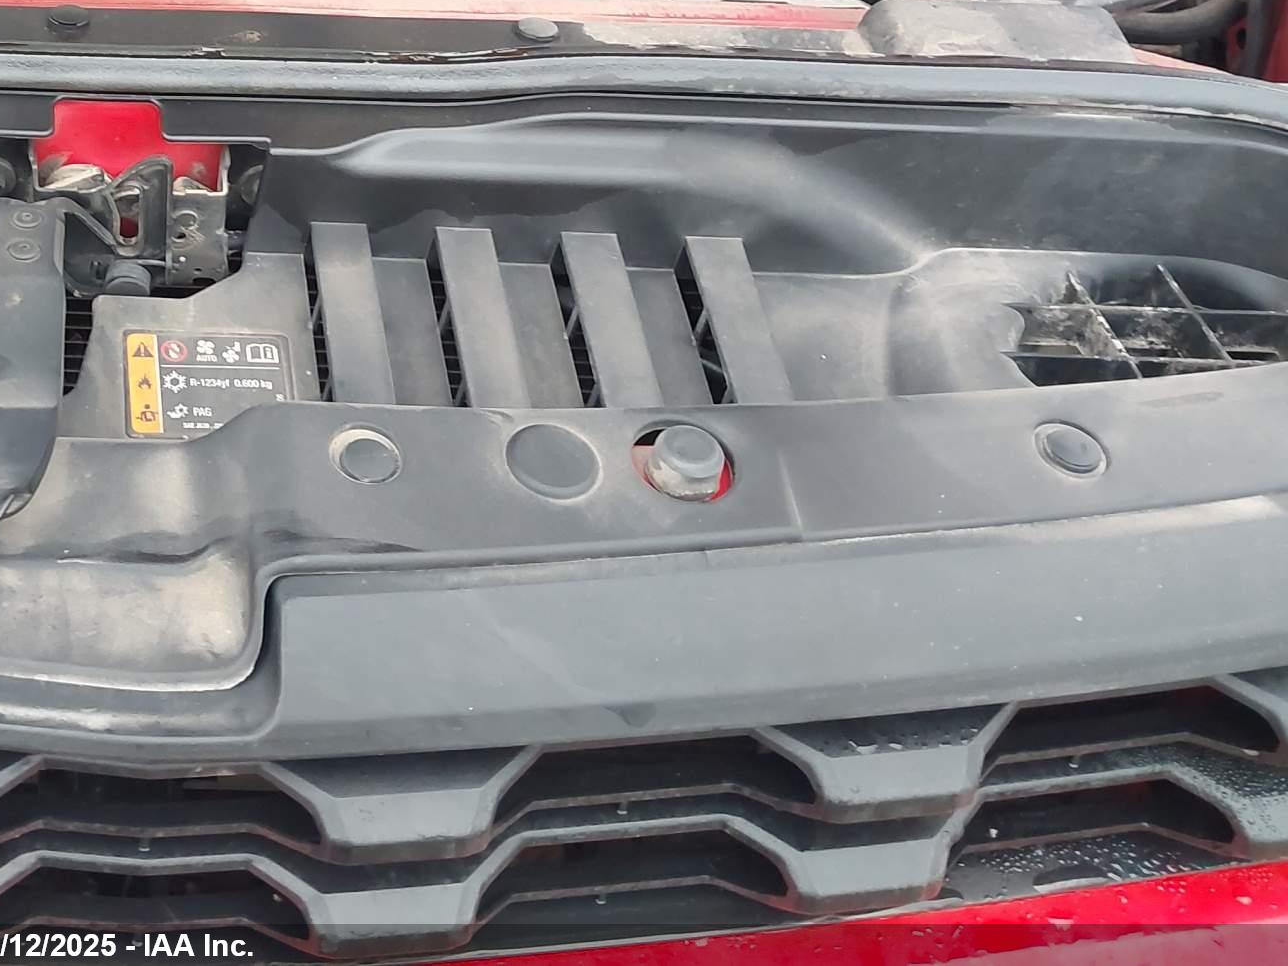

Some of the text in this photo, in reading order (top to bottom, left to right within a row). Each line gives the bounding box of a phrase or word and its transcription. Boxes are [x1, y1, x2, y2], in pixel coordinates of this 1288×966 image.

[196, 354, 218, 362] AUTO
[189, 377, 273, 390] R-1234yf 0.600 kg
[192, 406, 213, 417] PAG
